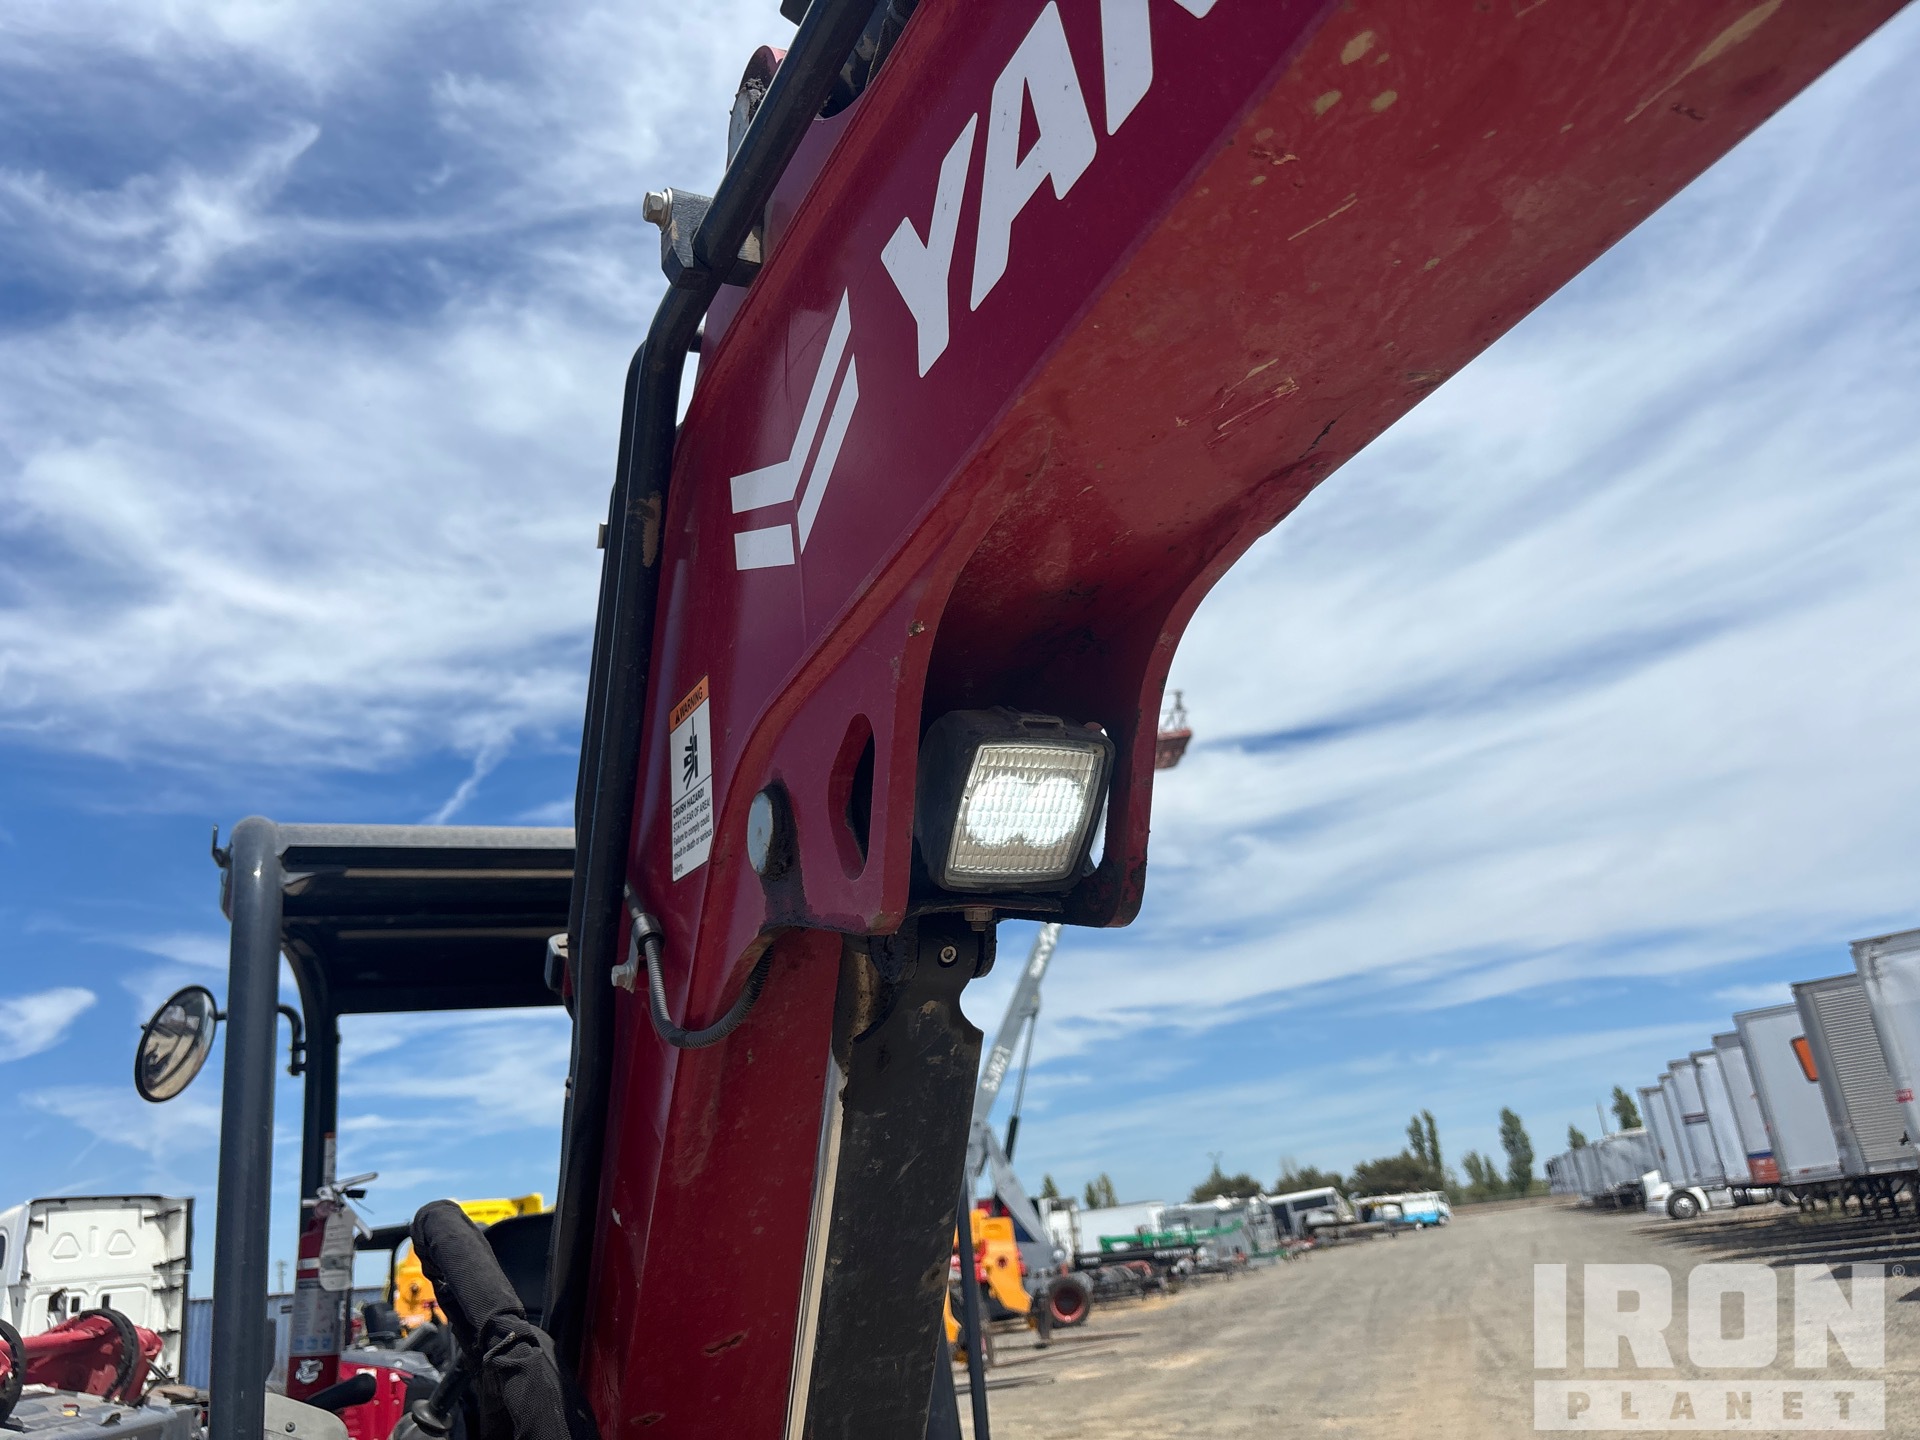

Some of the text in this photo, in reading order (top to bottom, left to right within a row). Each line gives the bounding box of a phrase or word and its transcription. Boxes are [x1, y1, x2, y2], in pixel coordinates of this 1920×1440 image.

[679, 686, 703, 719] WARNING
[673, 803, 686, 818] CRUSH
[683, 811, 694, 826] CLEAR
[674, 832, 684, 847] Failure
[688, 821, 699, 835] comply
[674, 847, 682, 861] result
[687, 839, 695, 851] death
[700, 828, 712, 843] serious
